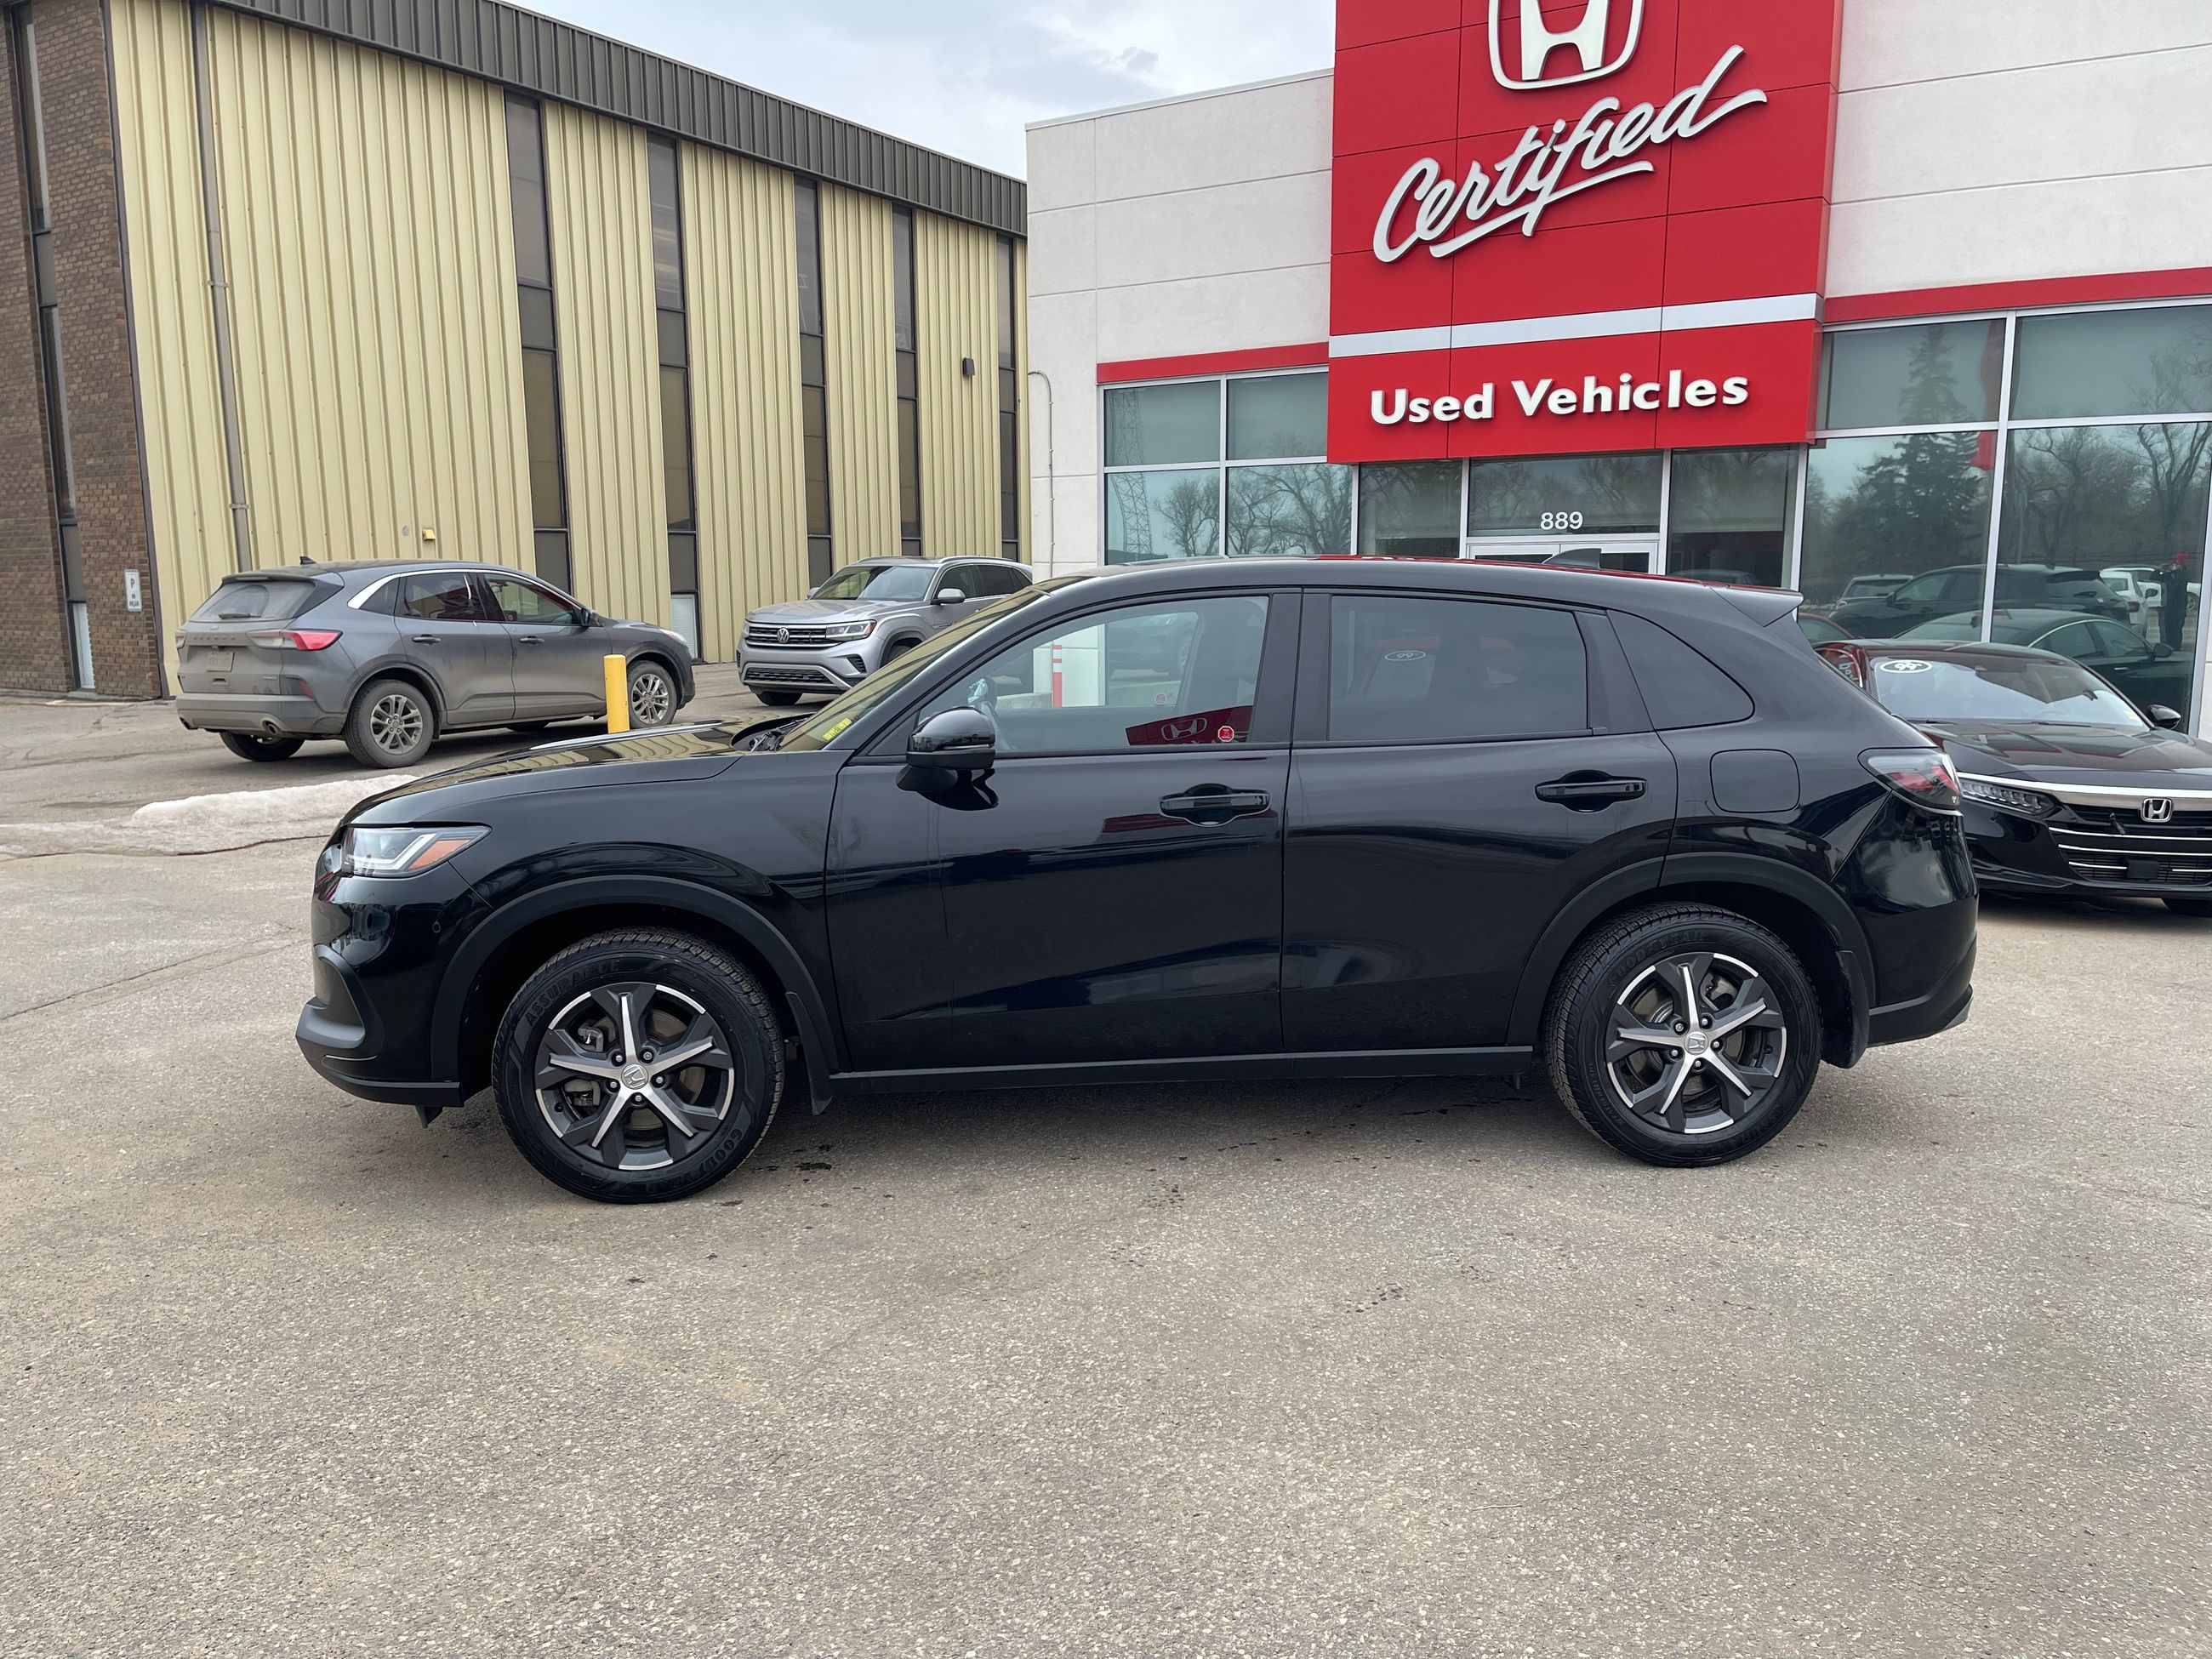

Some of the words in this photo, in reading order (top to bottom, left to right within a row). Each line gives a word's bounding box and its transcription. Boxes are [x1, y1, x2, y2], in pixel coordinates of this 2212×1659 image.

[1372, 44, 1767, 263] Certified
[1371, 383, 1496, 425] Used
[1512, 369, 1750, 417] Vehicles
[1540, 510, 1583, 530] 889
[525, 961, 621, 1024] ASSURANCE
